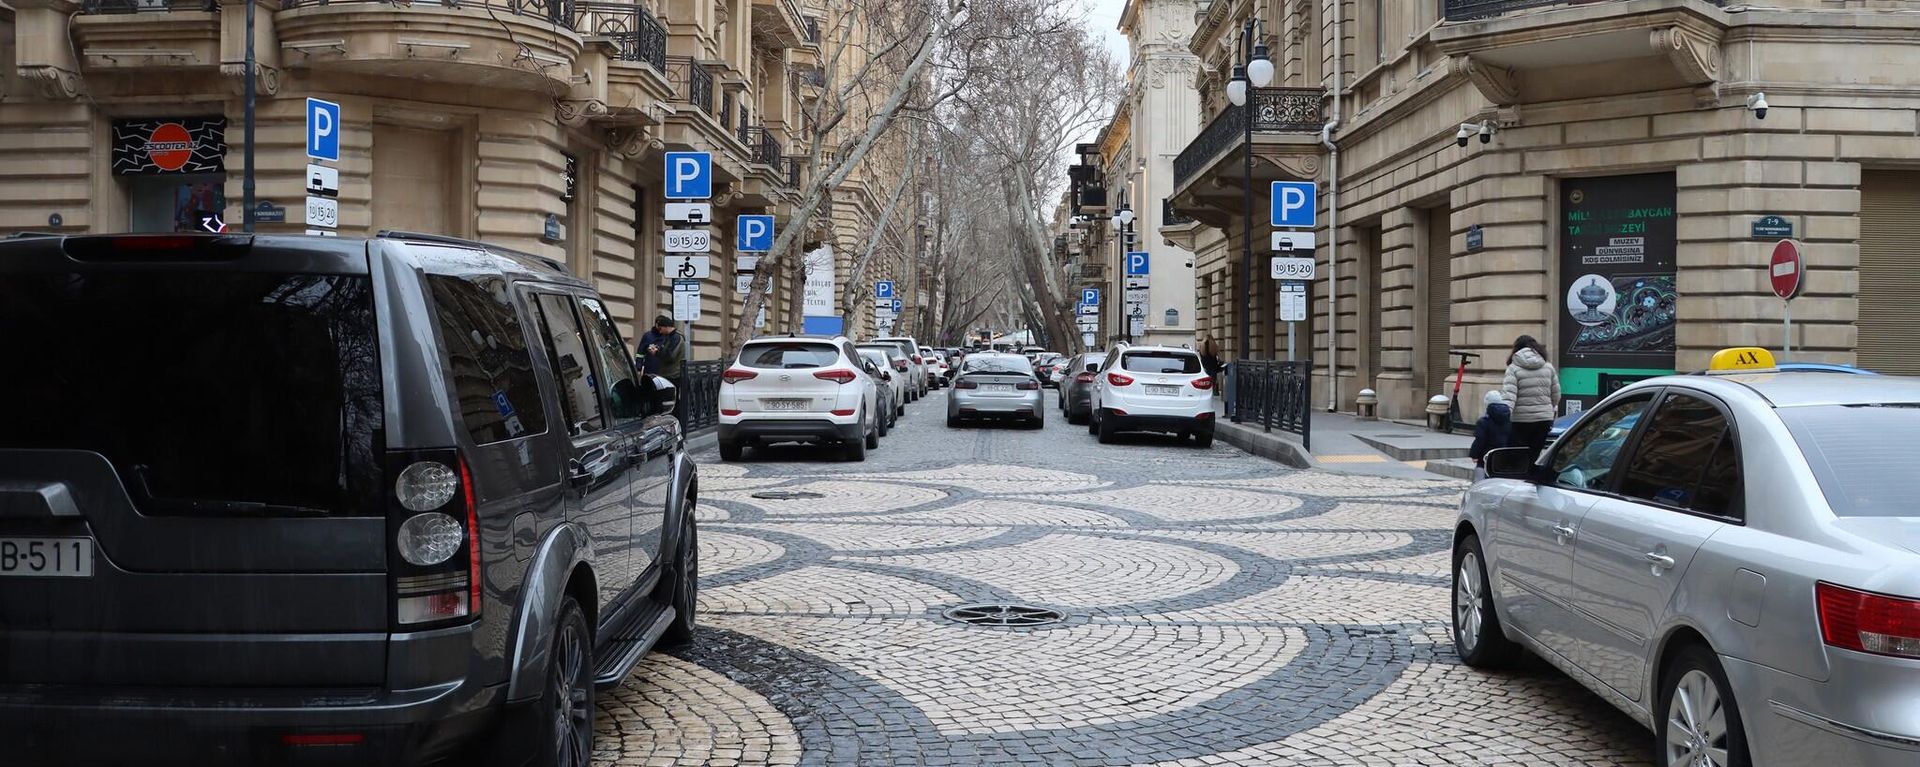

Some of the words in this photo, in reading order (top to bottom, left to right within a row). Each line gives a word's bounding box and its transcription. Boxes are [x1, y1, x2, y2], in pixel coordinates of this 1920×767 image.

[314, 106, 332, 150] P
[675, 157, 700, 193] P
[1281, 186, 1305, 221] P
[326, 208, 335, 218] 20
[1767, 218, 1779, 226] 7-9
[746, 219, 766, 247] P
[681, 237, 690, 245] 15
[694, 237, 706, 245] 20
[1131, 254, 1144, 273] P
[1276, 264, 1284, 272] 10
[1287, 264, 1296, 273] 15
[1299, 264, 1311, 273] 20
[879, 283, 889, 296] P
[1085, 291, 1095, 303] P
[893, 300, 902, 311] P
